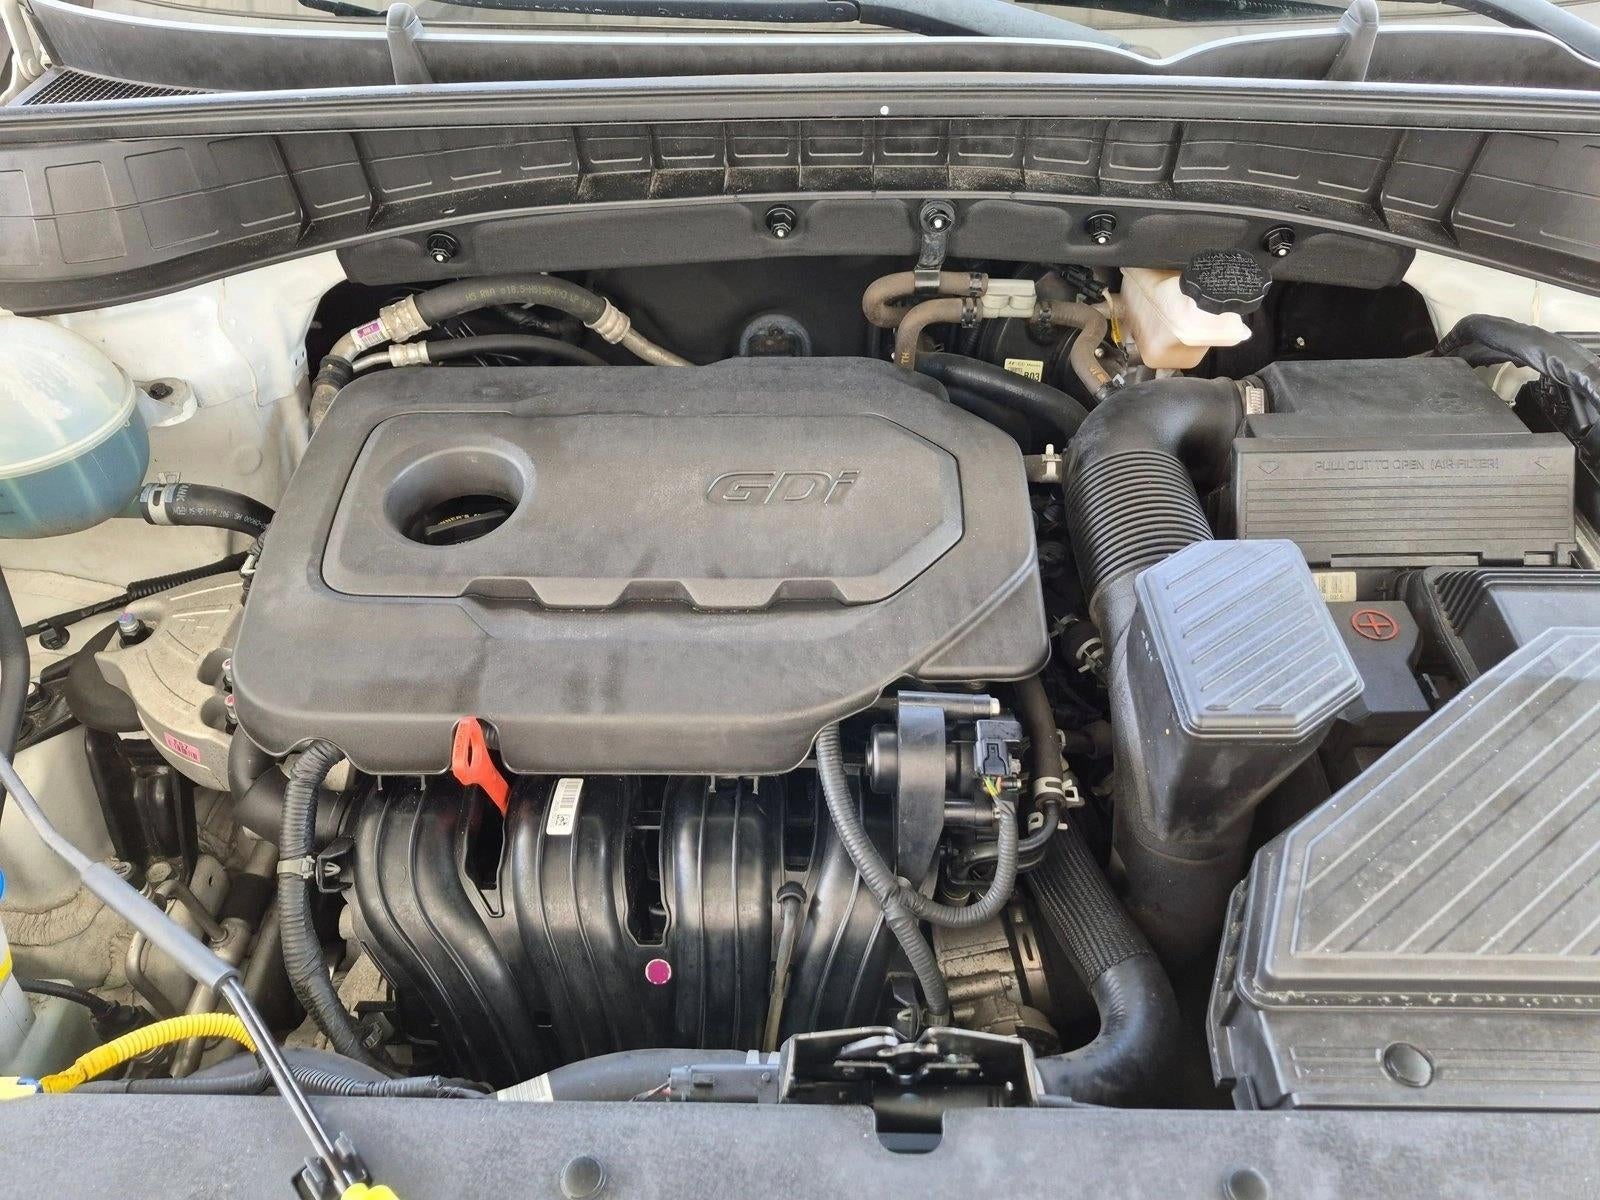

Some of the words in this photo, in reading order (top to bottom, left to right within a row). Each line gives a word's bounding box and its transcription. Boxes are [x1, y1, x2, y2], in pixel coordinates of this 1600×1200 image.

[1314, 460, 1345, 472] PULL
[1348, 459, 1372, 471] OUT
[1375, 459, 1389, 470] TO
[1392, 458, 1425, 471] OPEN
[705, 470, 860, 506] GDi
